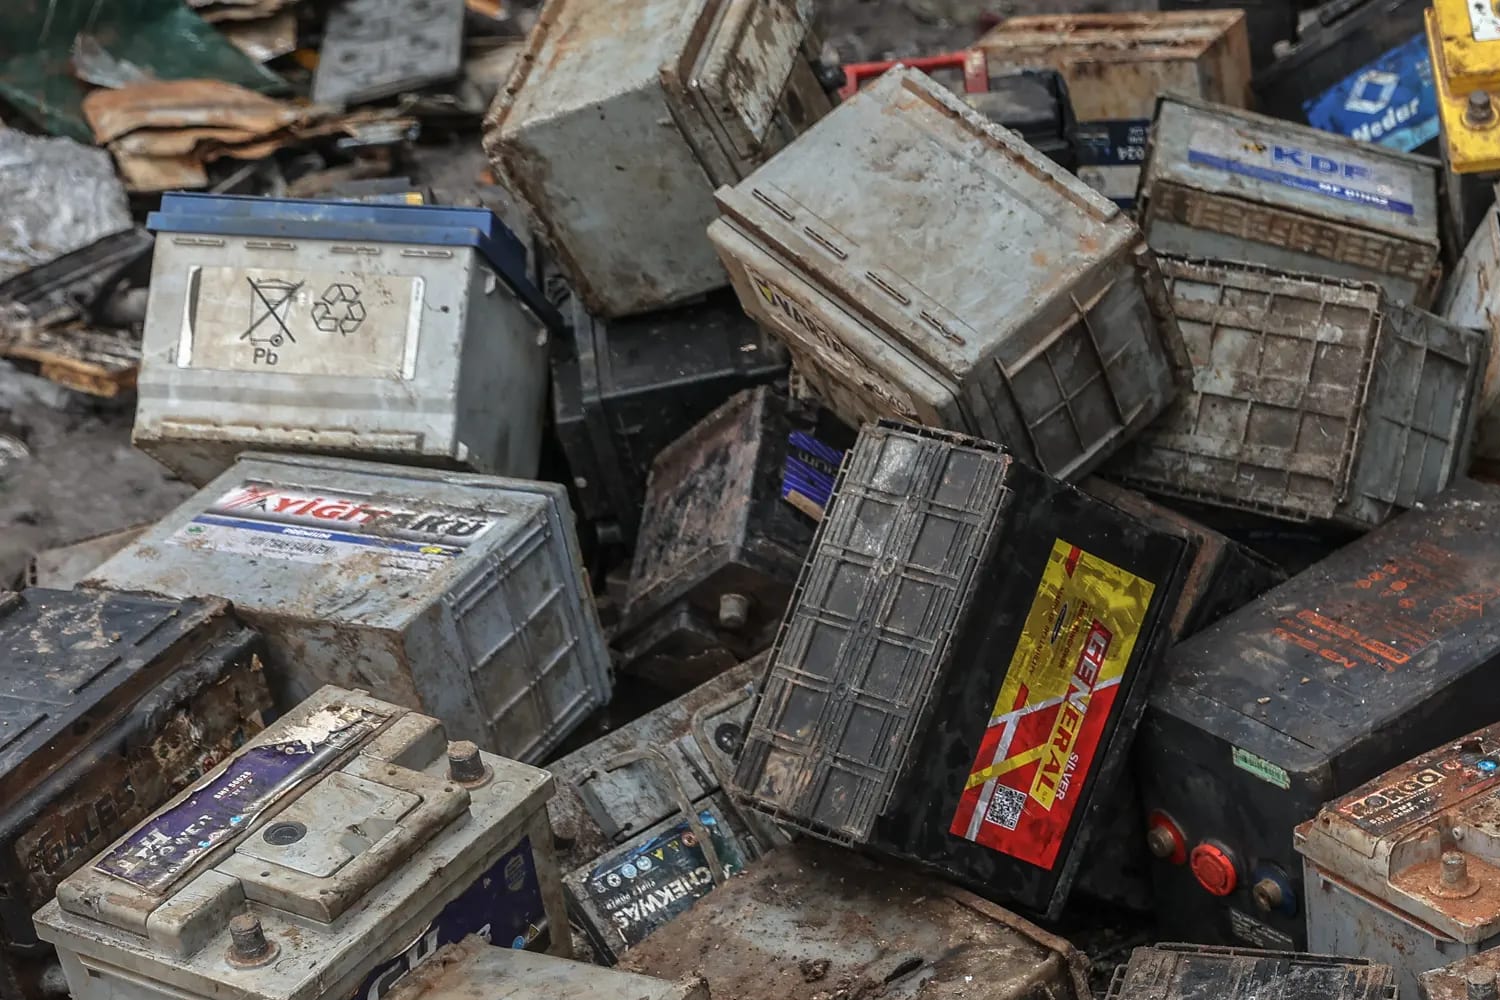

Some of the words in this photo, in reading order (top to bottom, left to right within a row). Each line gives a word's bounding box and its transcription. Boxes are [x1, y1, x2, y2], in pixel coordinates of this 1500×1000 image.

[1271, 145, 1370, 182] KDF
[252, 347, 278, 367] Pb
[1035, 626, 1111, 797] GENERAL
[1055, 751, 1080, 801] SILVER
